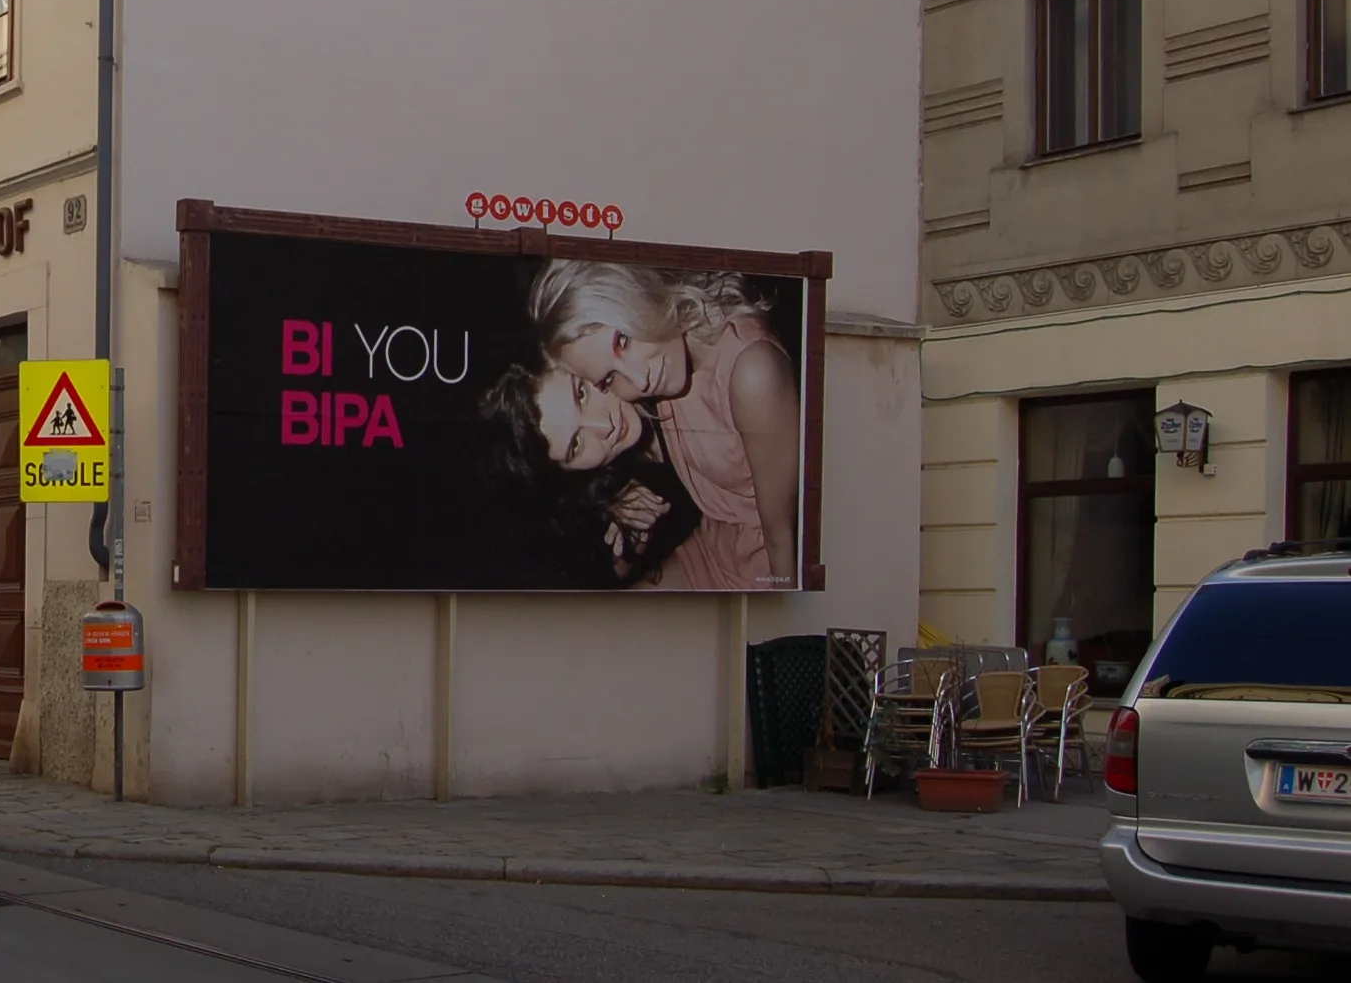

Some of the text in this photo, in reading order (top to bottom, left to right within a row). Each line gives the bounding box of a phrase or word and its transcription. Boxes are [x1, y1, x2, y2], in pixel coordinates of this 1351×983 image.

[67, 199, 82, 223] 92
[471, 197, 619, 225] gewista
[282, 320, 469, 383] BI YOU
[282, 390, 404, 448] BIPA
